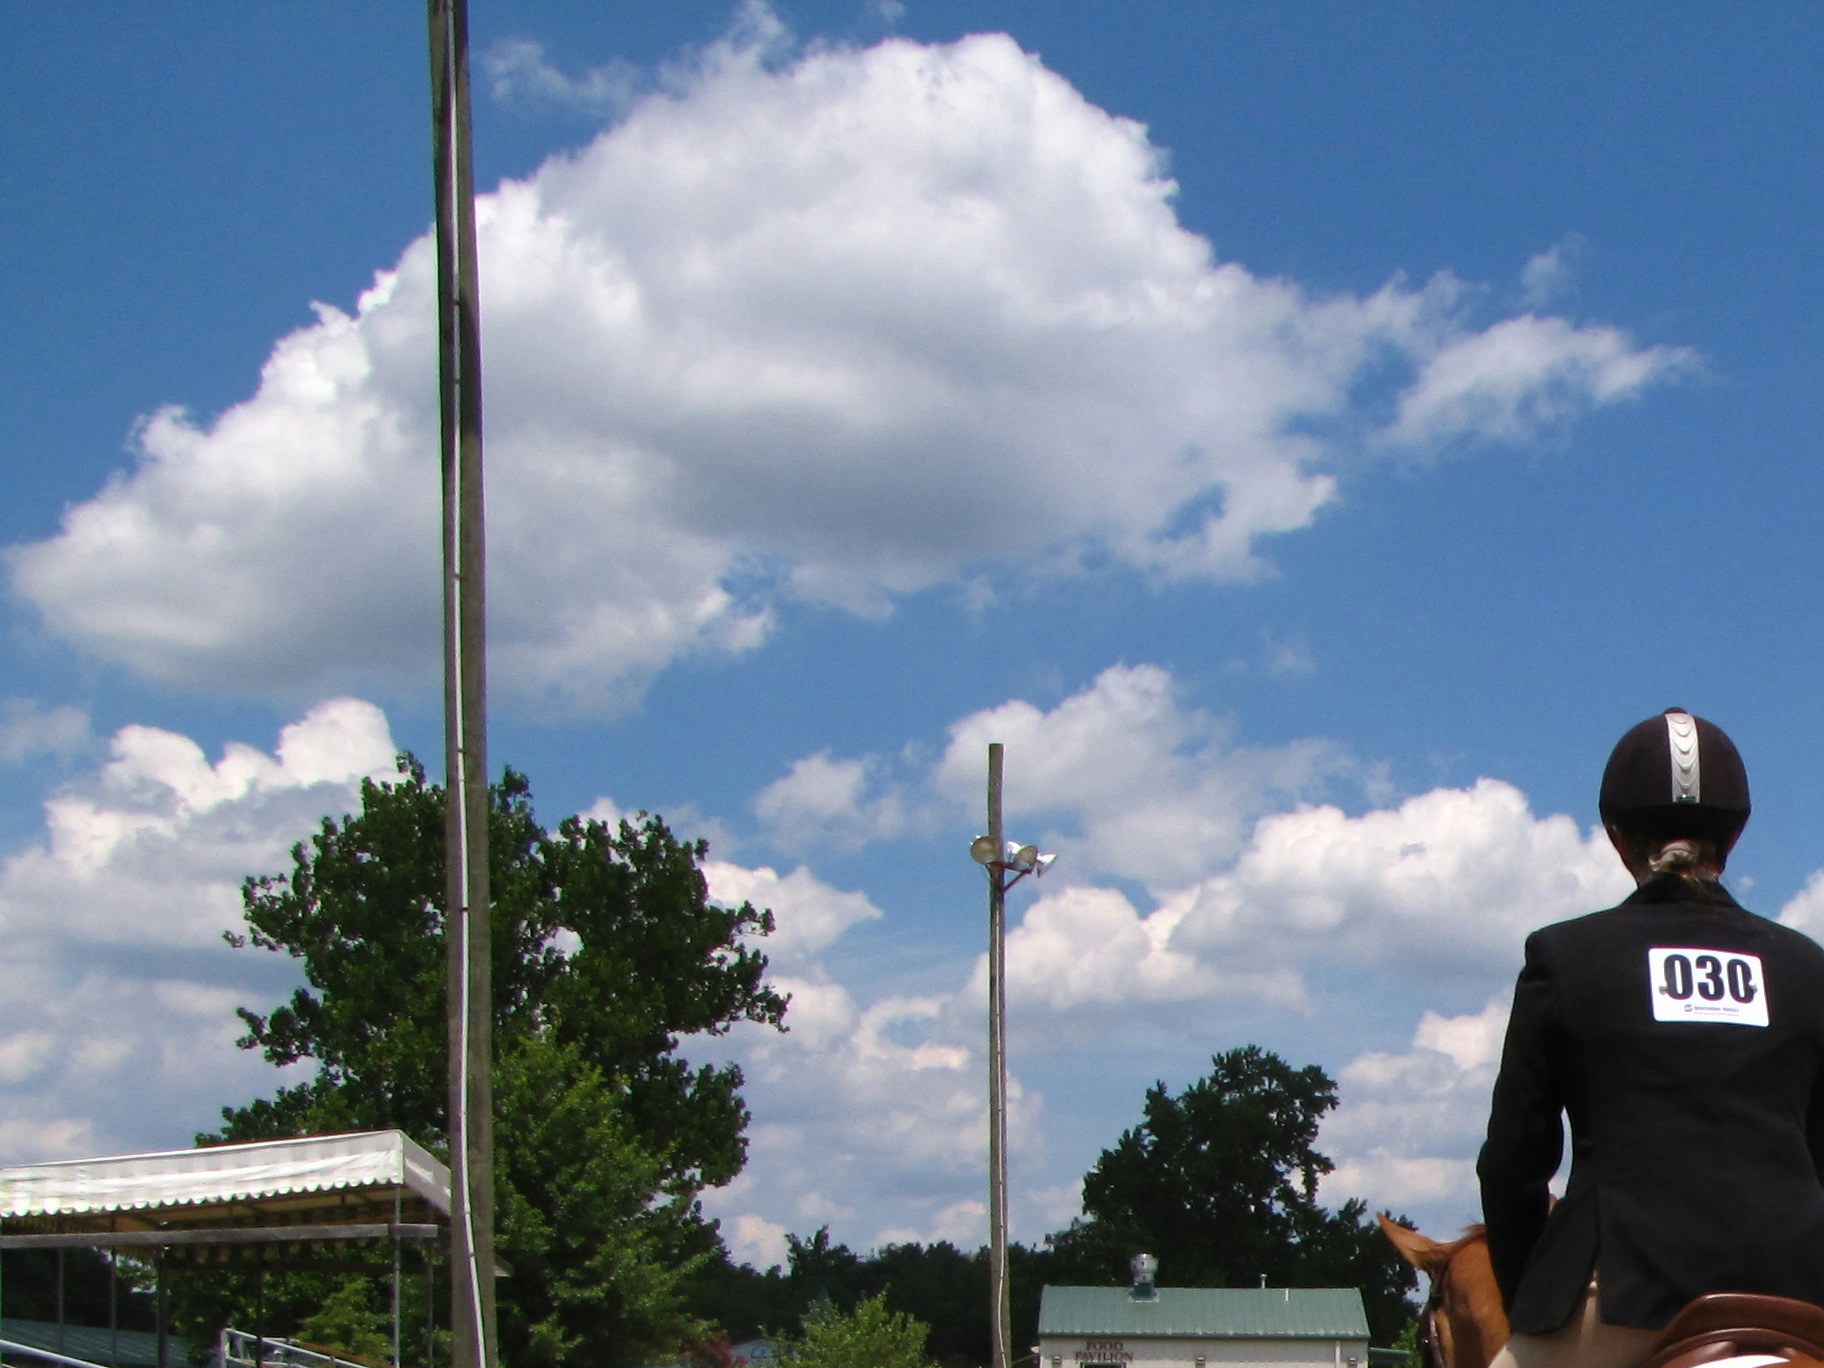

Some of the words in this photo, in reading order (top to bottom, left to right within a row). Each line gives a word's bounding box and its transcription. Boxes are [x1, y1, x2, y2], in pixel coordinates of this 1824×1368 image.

[1663, 953, 1756, 1004] 030
[1086, 1341, 1124, 1351] FOOD
[1075, 1351, 1134, 1362] PAVILION
